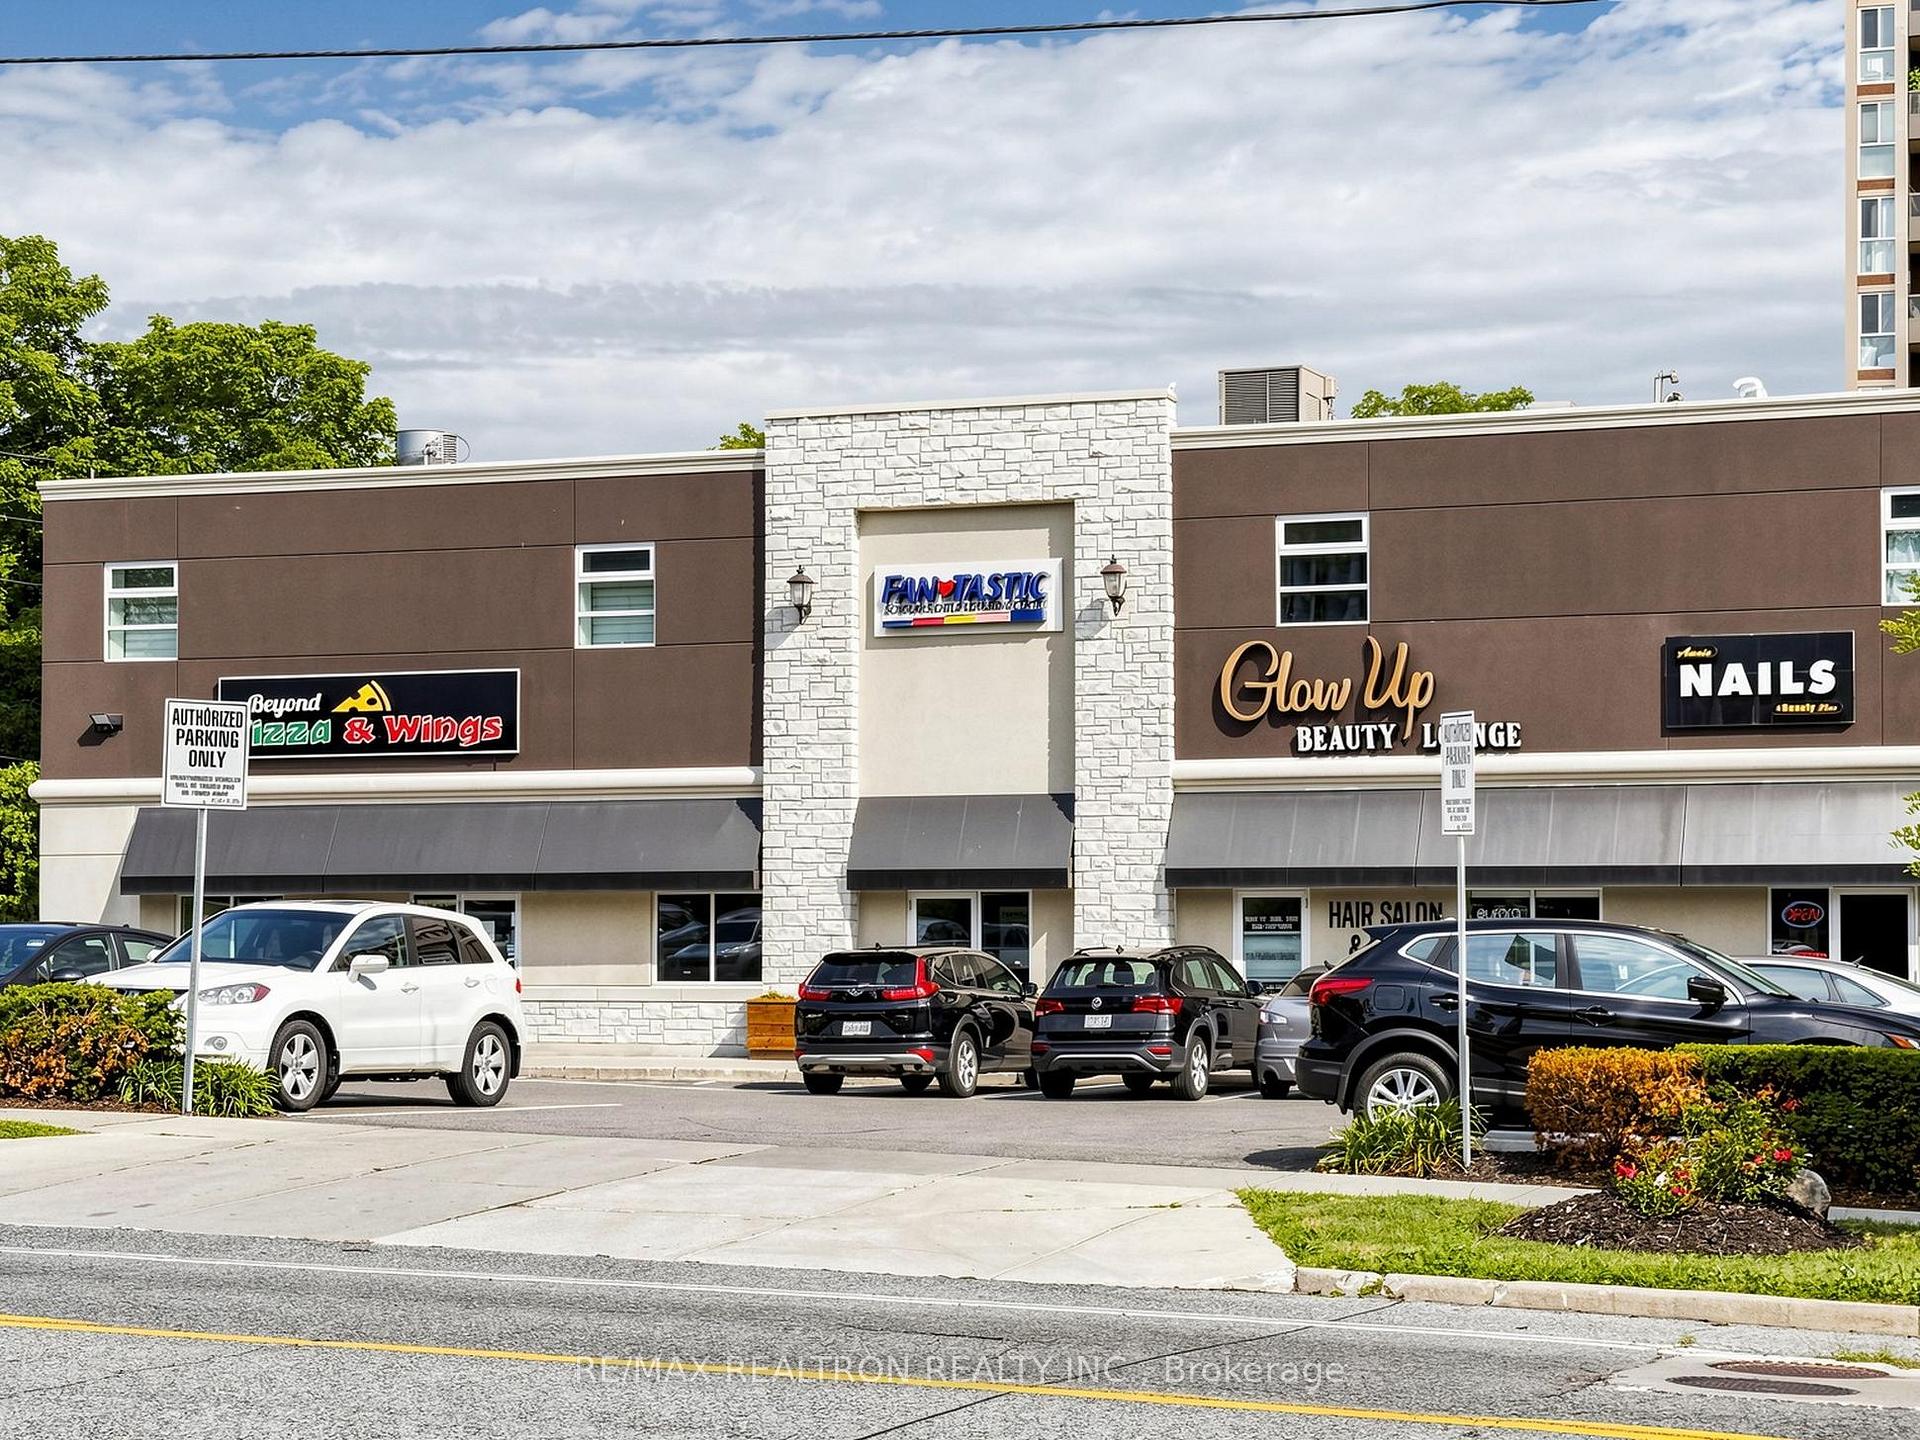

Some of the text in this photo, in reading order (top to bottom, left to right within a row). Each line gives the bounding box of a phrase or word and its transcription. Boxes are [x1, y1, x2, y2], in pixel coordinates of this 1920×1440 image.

[1221, 635, 1434, 740] Glow Up
[1680, 659, 1836, 697] NAILS
[172, 707, 243, 728] AUTHORIZED
[248, 692, 322, 718] Beyond
[176, 728, 239, 748] PARKING
[249, 714, 503, 747] izza & Wings
[1296, 722, 1522, 752] BEAUTY LNGE
[188, 749, 227, 768] ONLY
[1329, 901, 1443, 928] HAIR SALON
